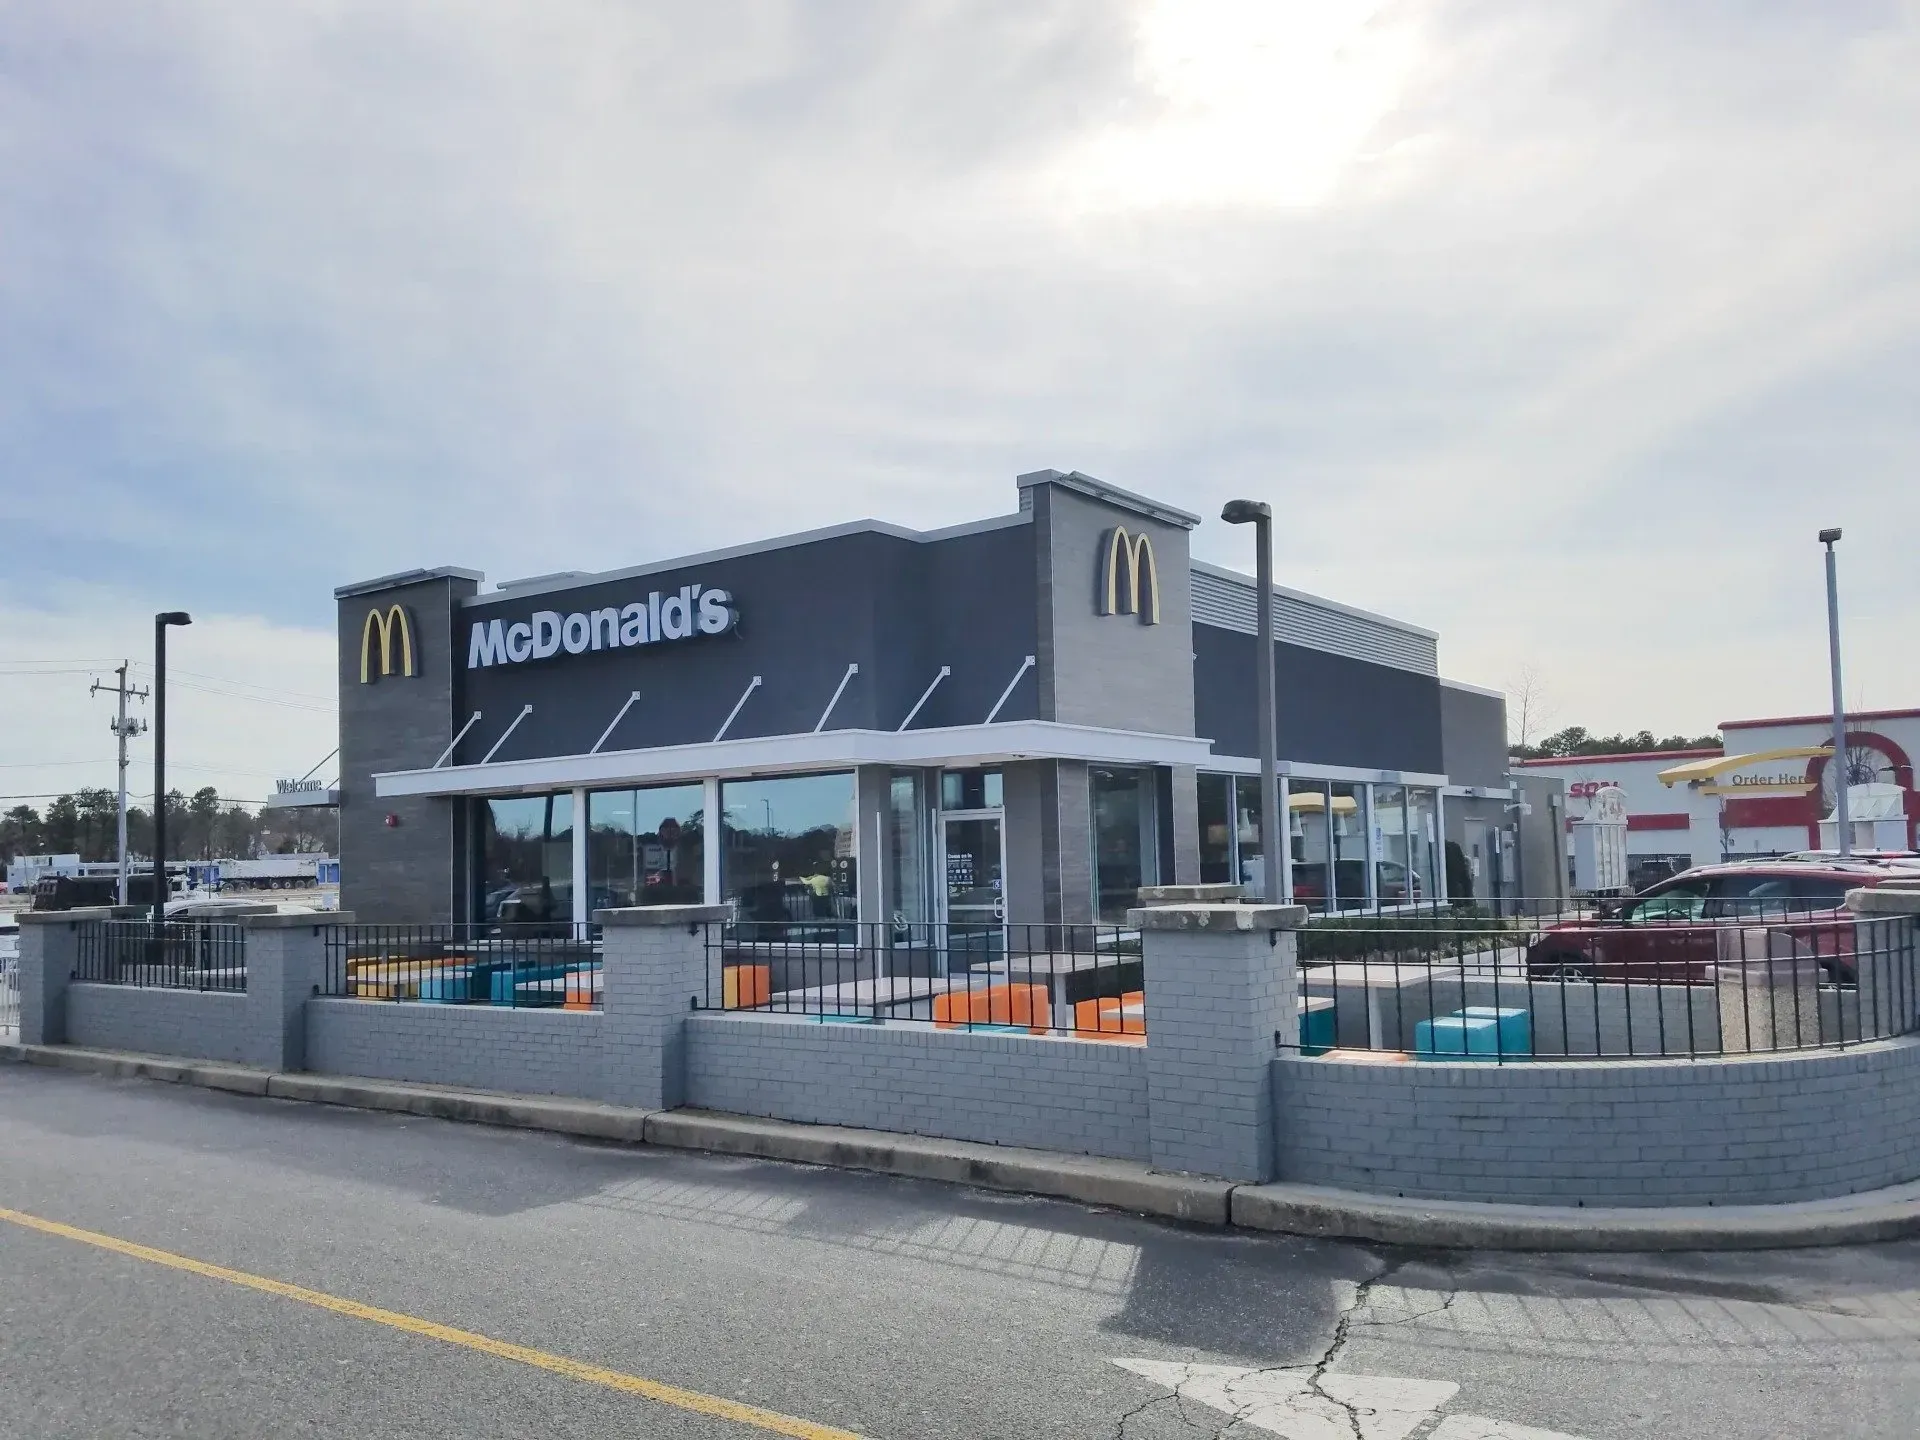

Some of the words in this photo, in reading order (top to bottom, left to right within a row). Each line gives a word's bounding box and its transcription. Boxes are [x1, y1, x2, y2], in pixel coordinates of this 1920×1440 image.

[467, 584, 731, 669] McDonald's
[276, 779, 322, 793] Welcome
[1732, 774, 1773, 786] Order
